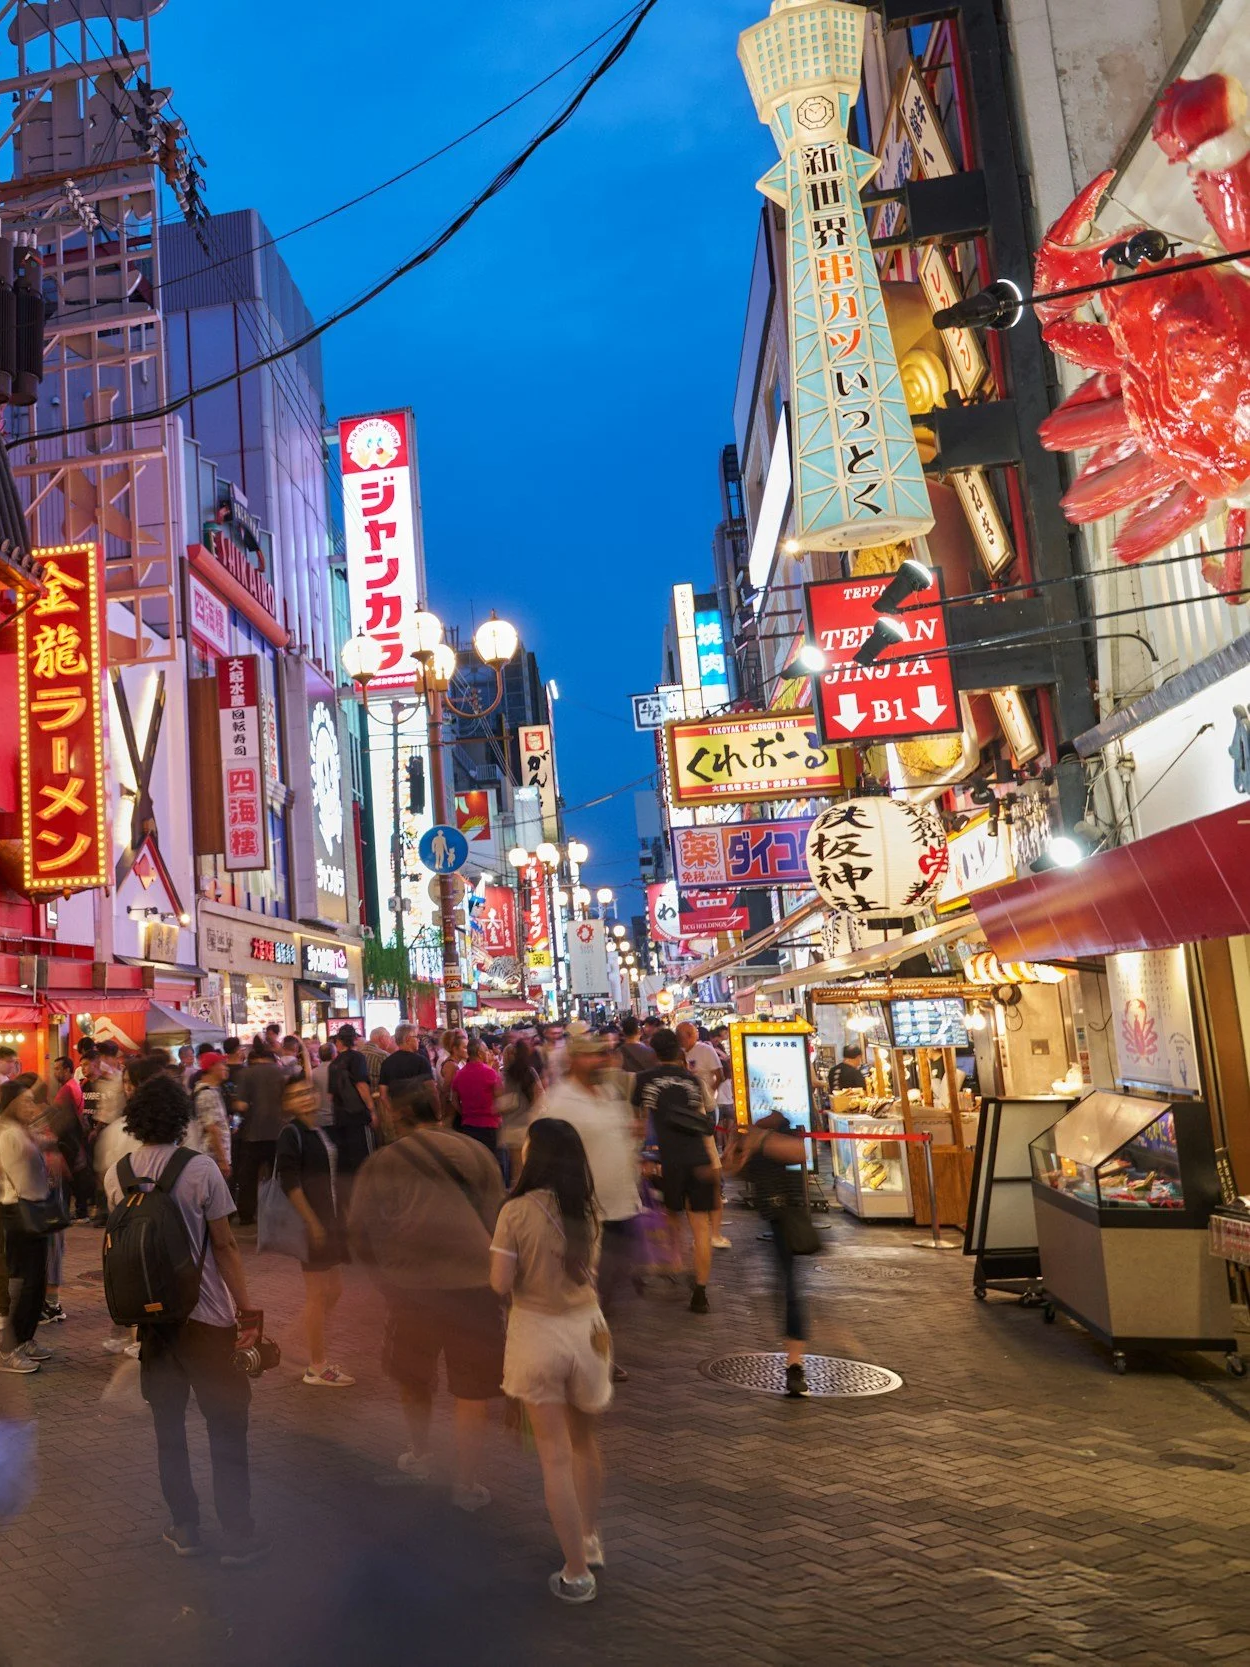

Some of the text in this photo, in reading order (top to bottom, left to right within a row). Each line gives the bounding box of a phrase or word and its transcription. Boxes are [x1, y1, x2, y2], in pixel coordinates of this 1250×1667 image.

[361, 476, 403, 671] ジャンカラ
[29, 560, 93, 873] 金龍ラーメン
[231, 709, 247, 756] 回転寿司
[871, 698, 908, 723] B1
[686, 731, 829, 782] くれおーる
[681, 830, 809, 876] 薬 ダイコ
[708, 869, 722, 877] TAX
[809, 805, 890, 915] 鉄板神社
[681, 872, 706, 883] 免税
[706, 875, 724, 883] FREE
